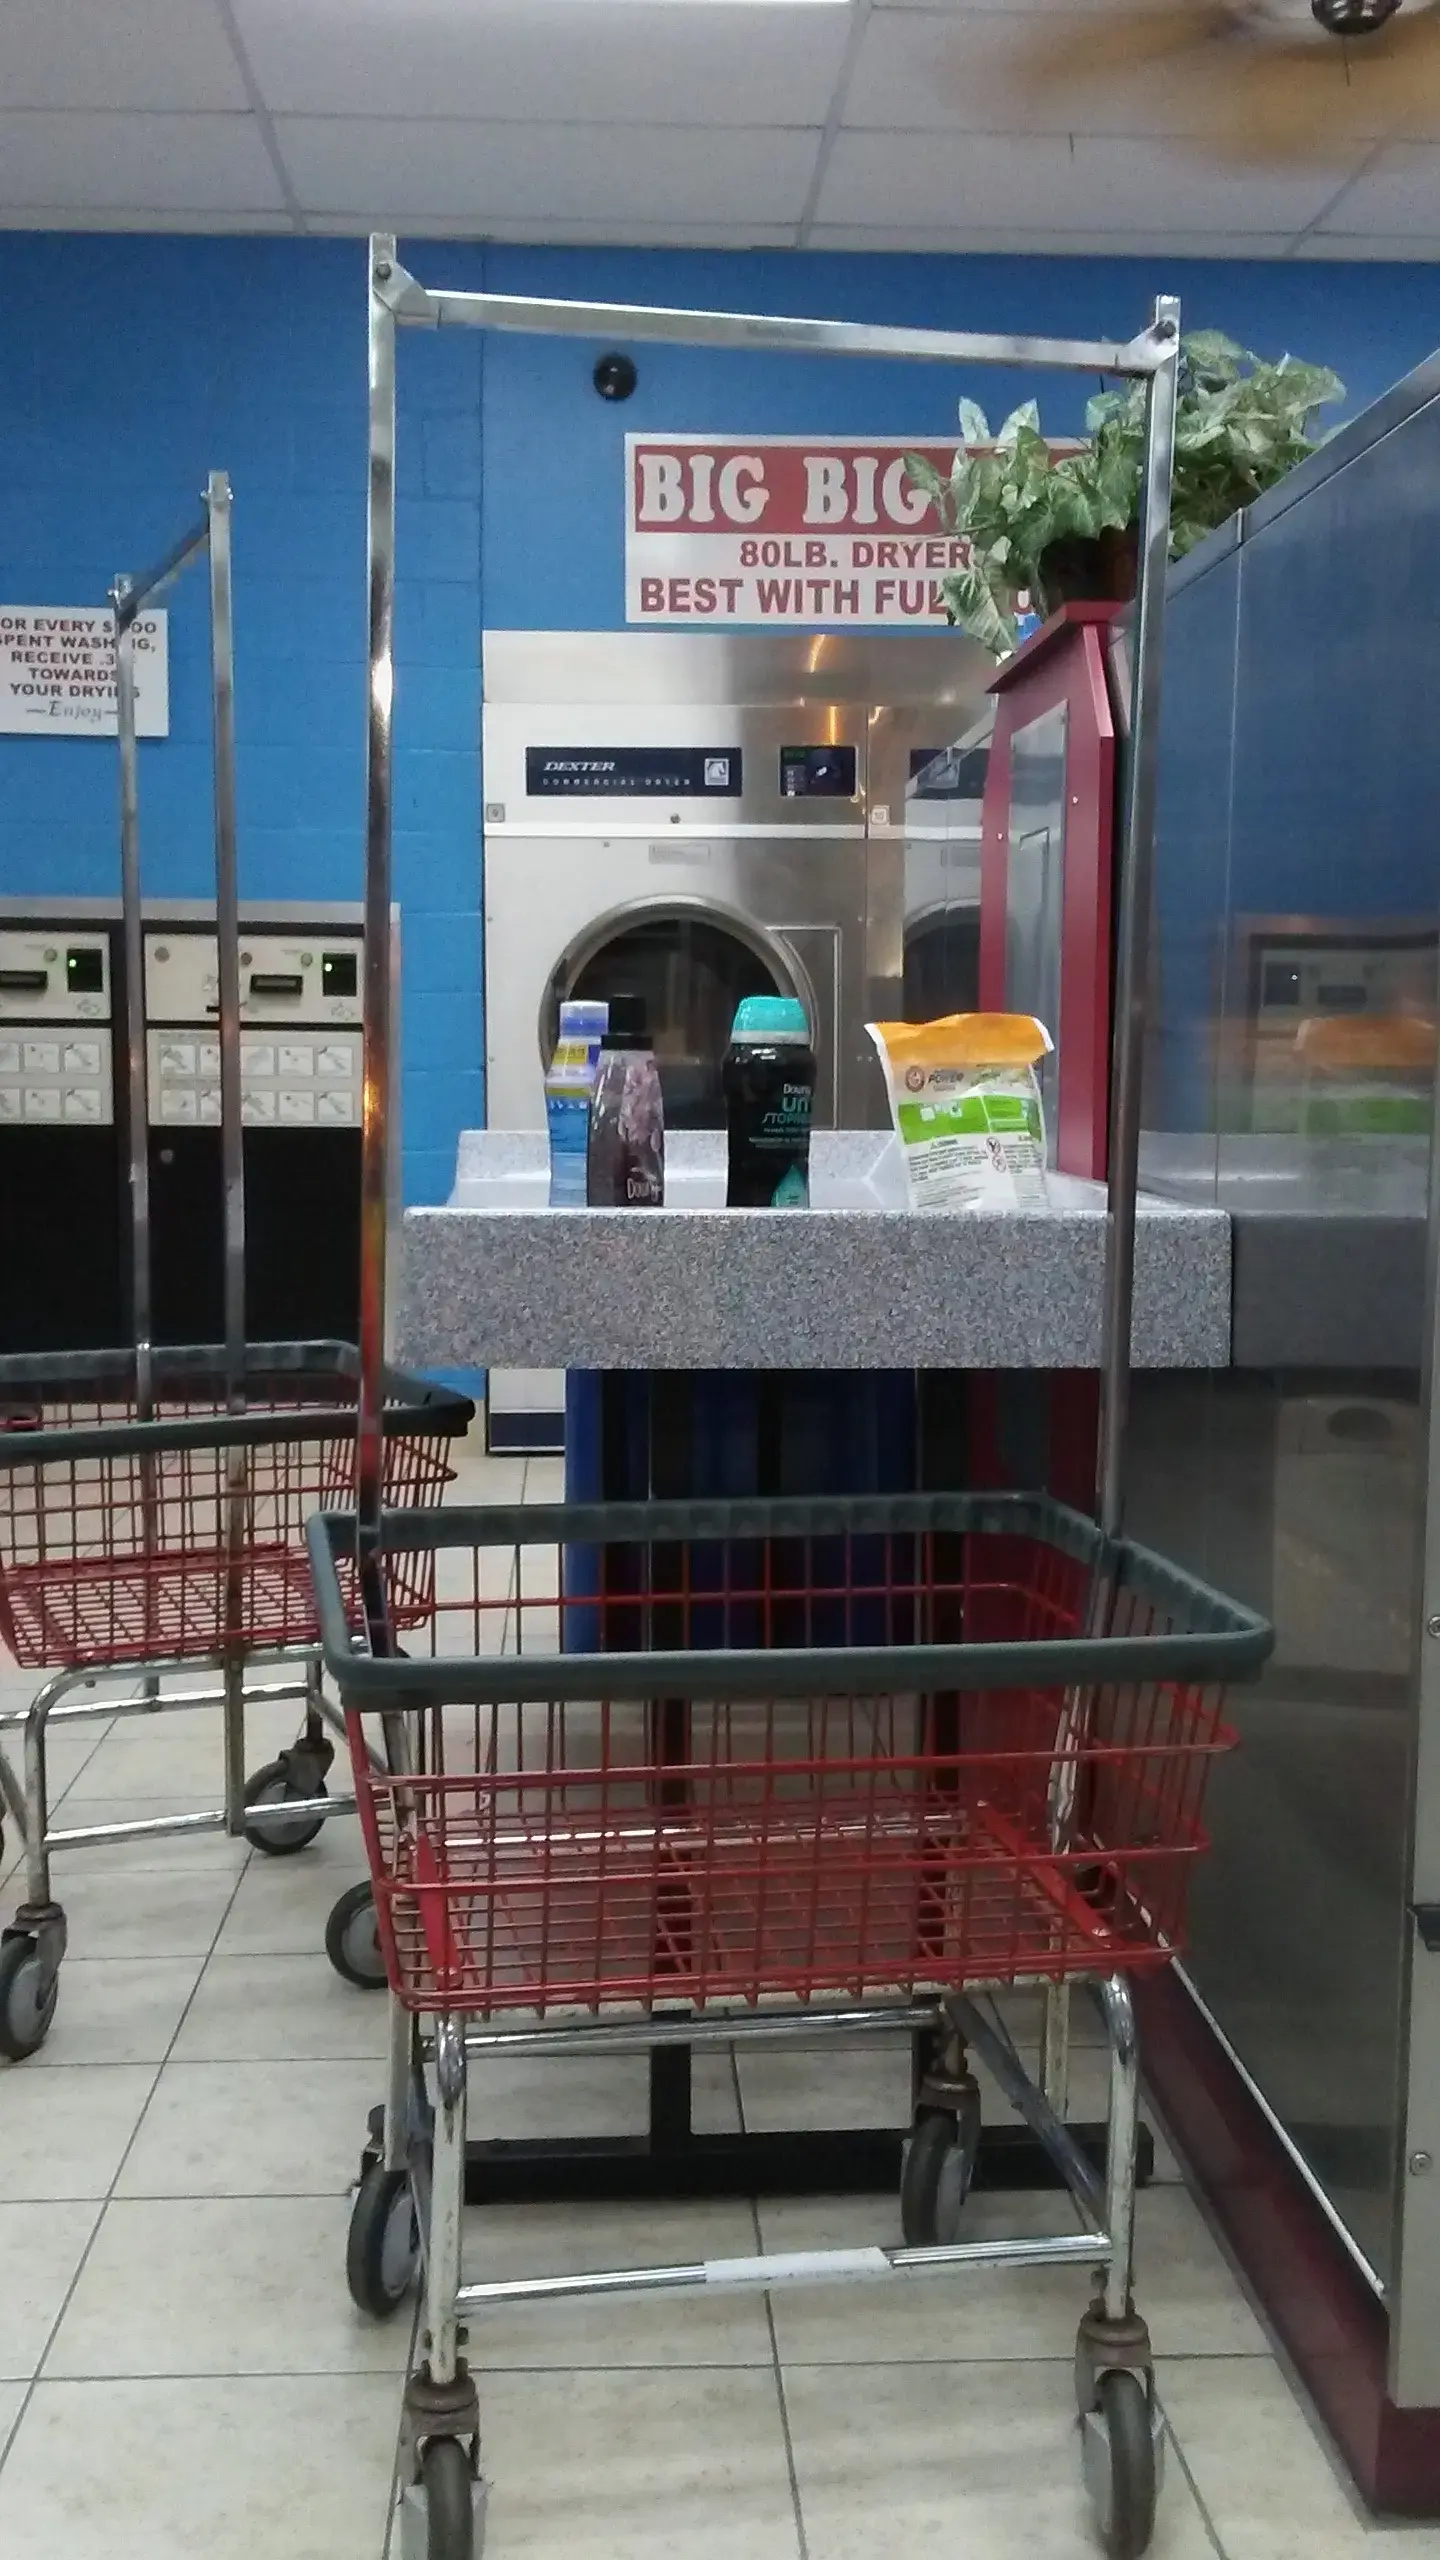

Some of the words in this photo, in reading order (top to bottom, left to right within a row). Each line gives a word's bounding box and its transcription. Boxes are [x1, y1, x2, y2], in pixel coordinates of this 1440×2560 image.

[638, 453, 769, 524] BIG
[802, 456, 934, 526] BIG
[739, 540, 838, 569] 80LB.
[851, 540, 971, 571] DRYER
[641, 577, 743, 613] BEST
[757, 579, 859, 615] WITH
[875, 579, 950, 616] FUL
[0, 617, 27, 630] OR
[34, 618, 96, 633] EVERY
[0, 634, 54, 648] PENT
[60, 636, 156, 653] WASHG,
[11, 651, 92, 665] RECEIVE
[9, 683, 64, 697] YOUR
[69, 685, 140, 699] DRYIG
[543, 761, 616, 772] DEXTER
